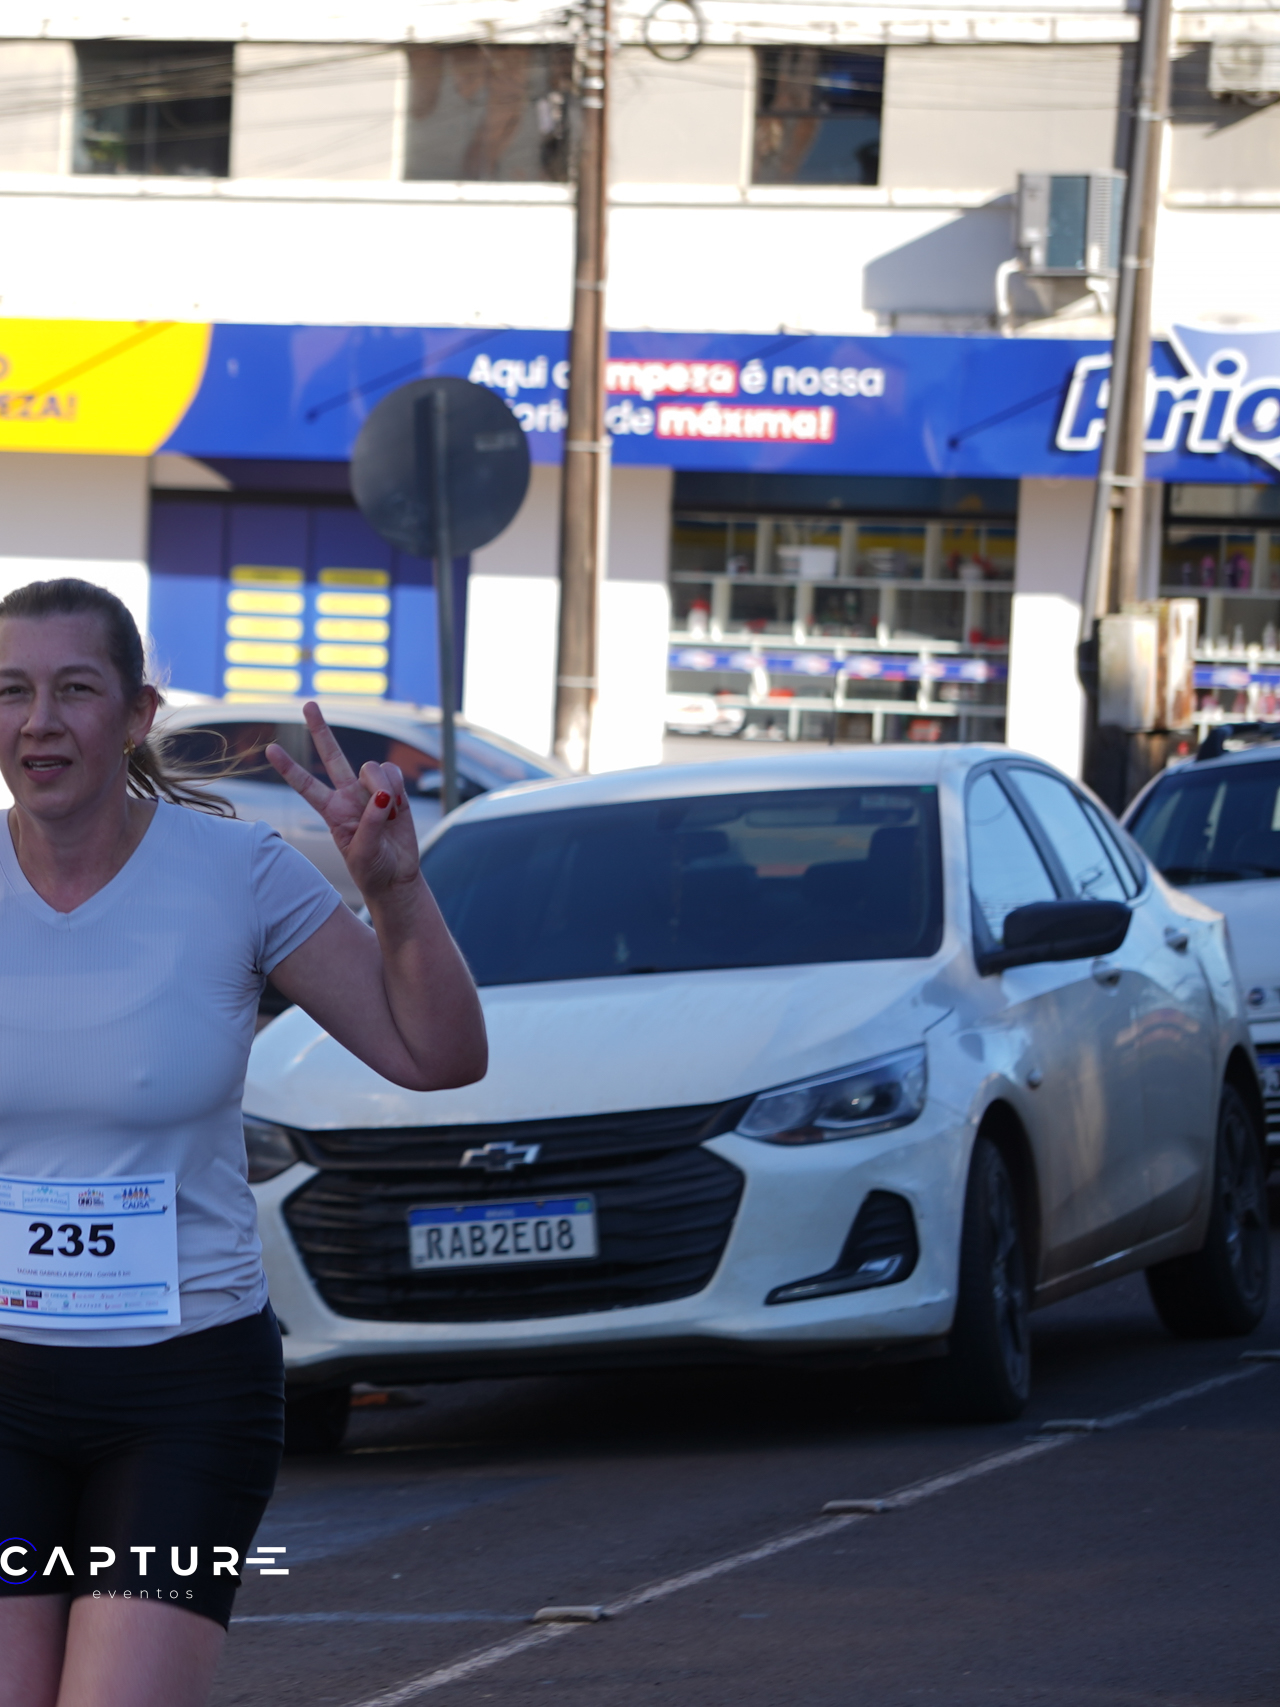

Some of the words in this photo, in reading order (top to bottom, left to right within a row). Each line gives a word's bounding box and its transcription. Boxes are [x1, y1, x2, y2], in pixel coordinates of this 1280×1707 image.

[468, 353, 549, 397] Aqui
[740, 359, 767, 394] é
[772, 366, 885, 397] nossa
[658, 401, 834, 440] máxima!
[28, 1222, 116, 1257] 235
[426, 1218, 575, 1260] RAB2E08
